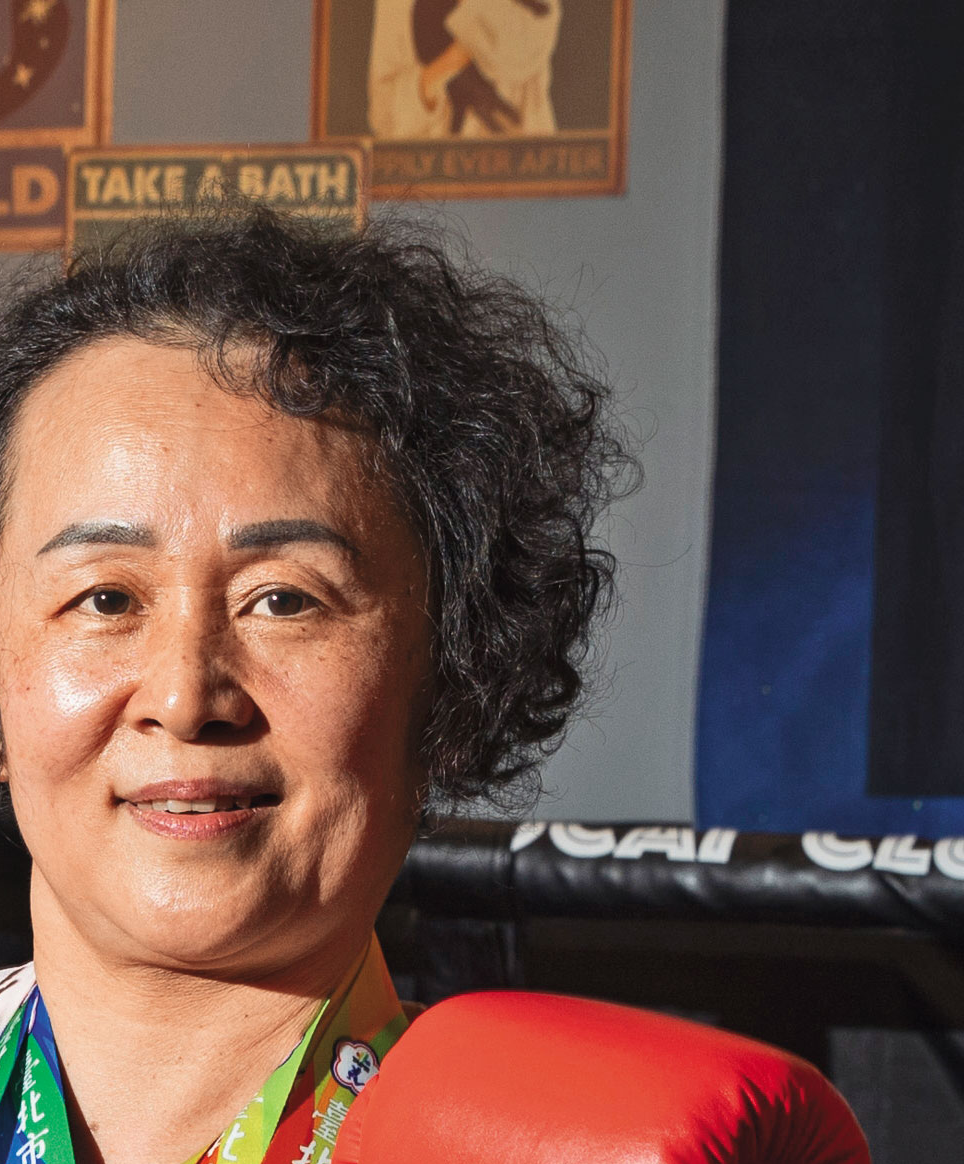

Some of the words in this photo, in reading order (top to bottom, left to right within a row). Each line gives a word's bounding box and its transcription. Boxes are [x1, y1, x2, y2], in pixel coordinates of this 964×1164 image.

[82, 165, 187, 202] TAKE
[196, 163, 225, 202] A
[239, 163, 351, 201] BATH
